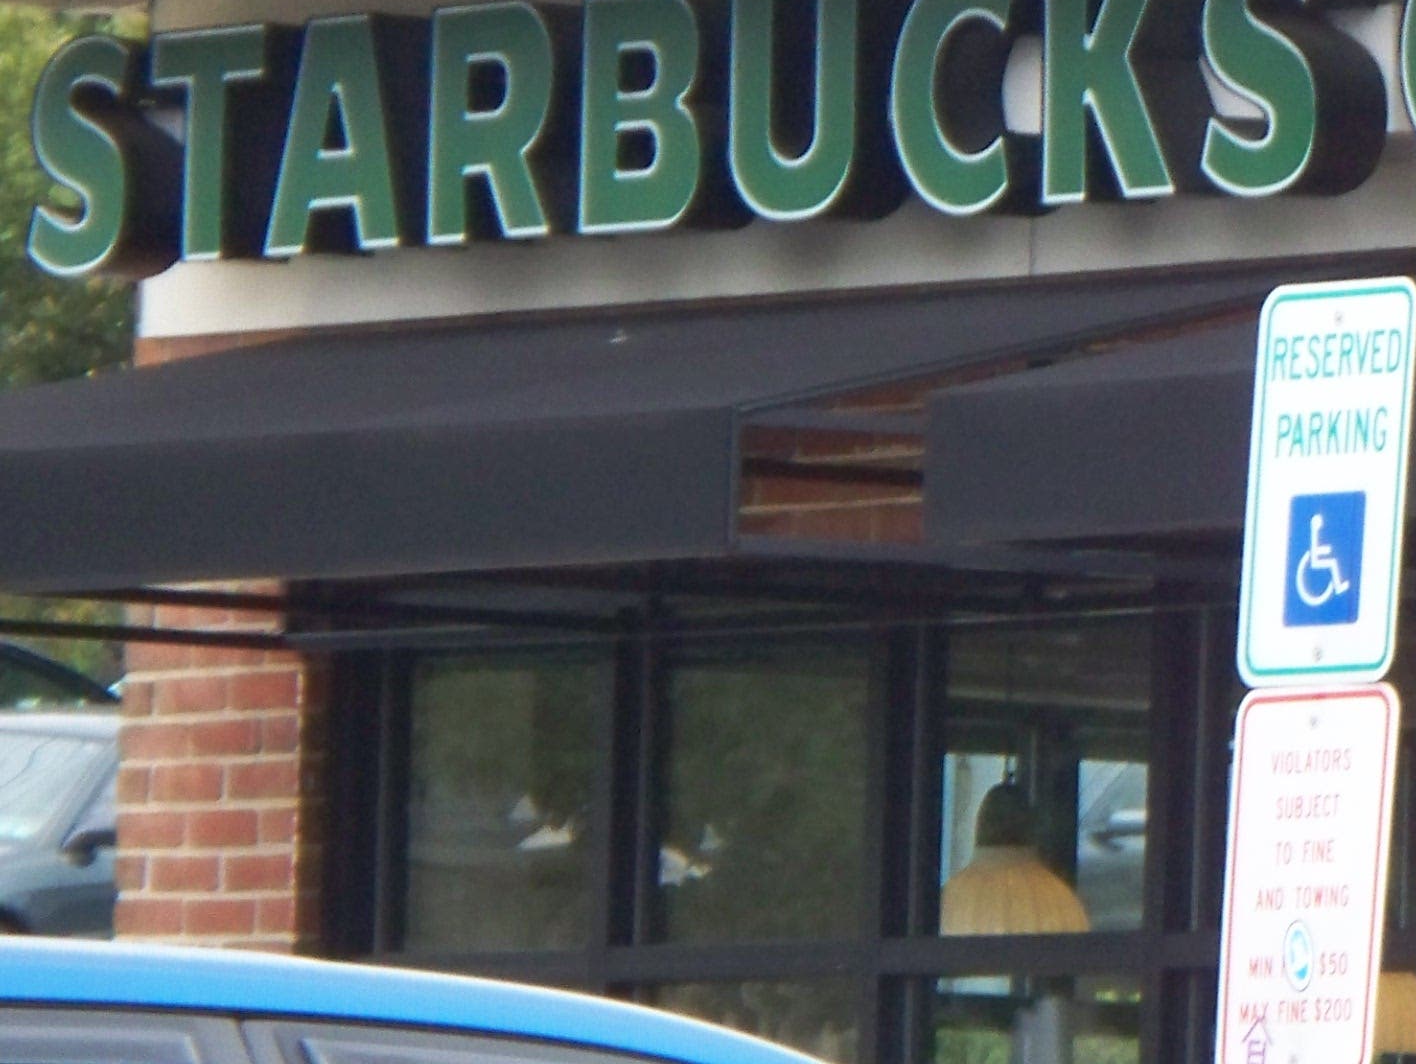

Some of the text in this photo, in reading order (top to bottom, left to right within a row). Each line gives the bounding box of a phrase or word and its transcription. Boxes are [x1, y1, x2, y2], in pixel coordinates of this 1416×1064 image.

[1271, 329, 1401, 381] RESERVED
[1276, 407, 1389, 457] PARKING
[1272, 748, 1353, 774] VIOLATORS
[1276, 793, 1340, 820] SUBJECT
[1276, 838, 1335, 865] TO FINE
[1255, 884, 1350, 911] AND TOWING
[1249, 954, 1273, 976] MIN
[1320, 951, 1348, 975] $50
[1240, 996, 1352, 1024] MAX FINE $200
